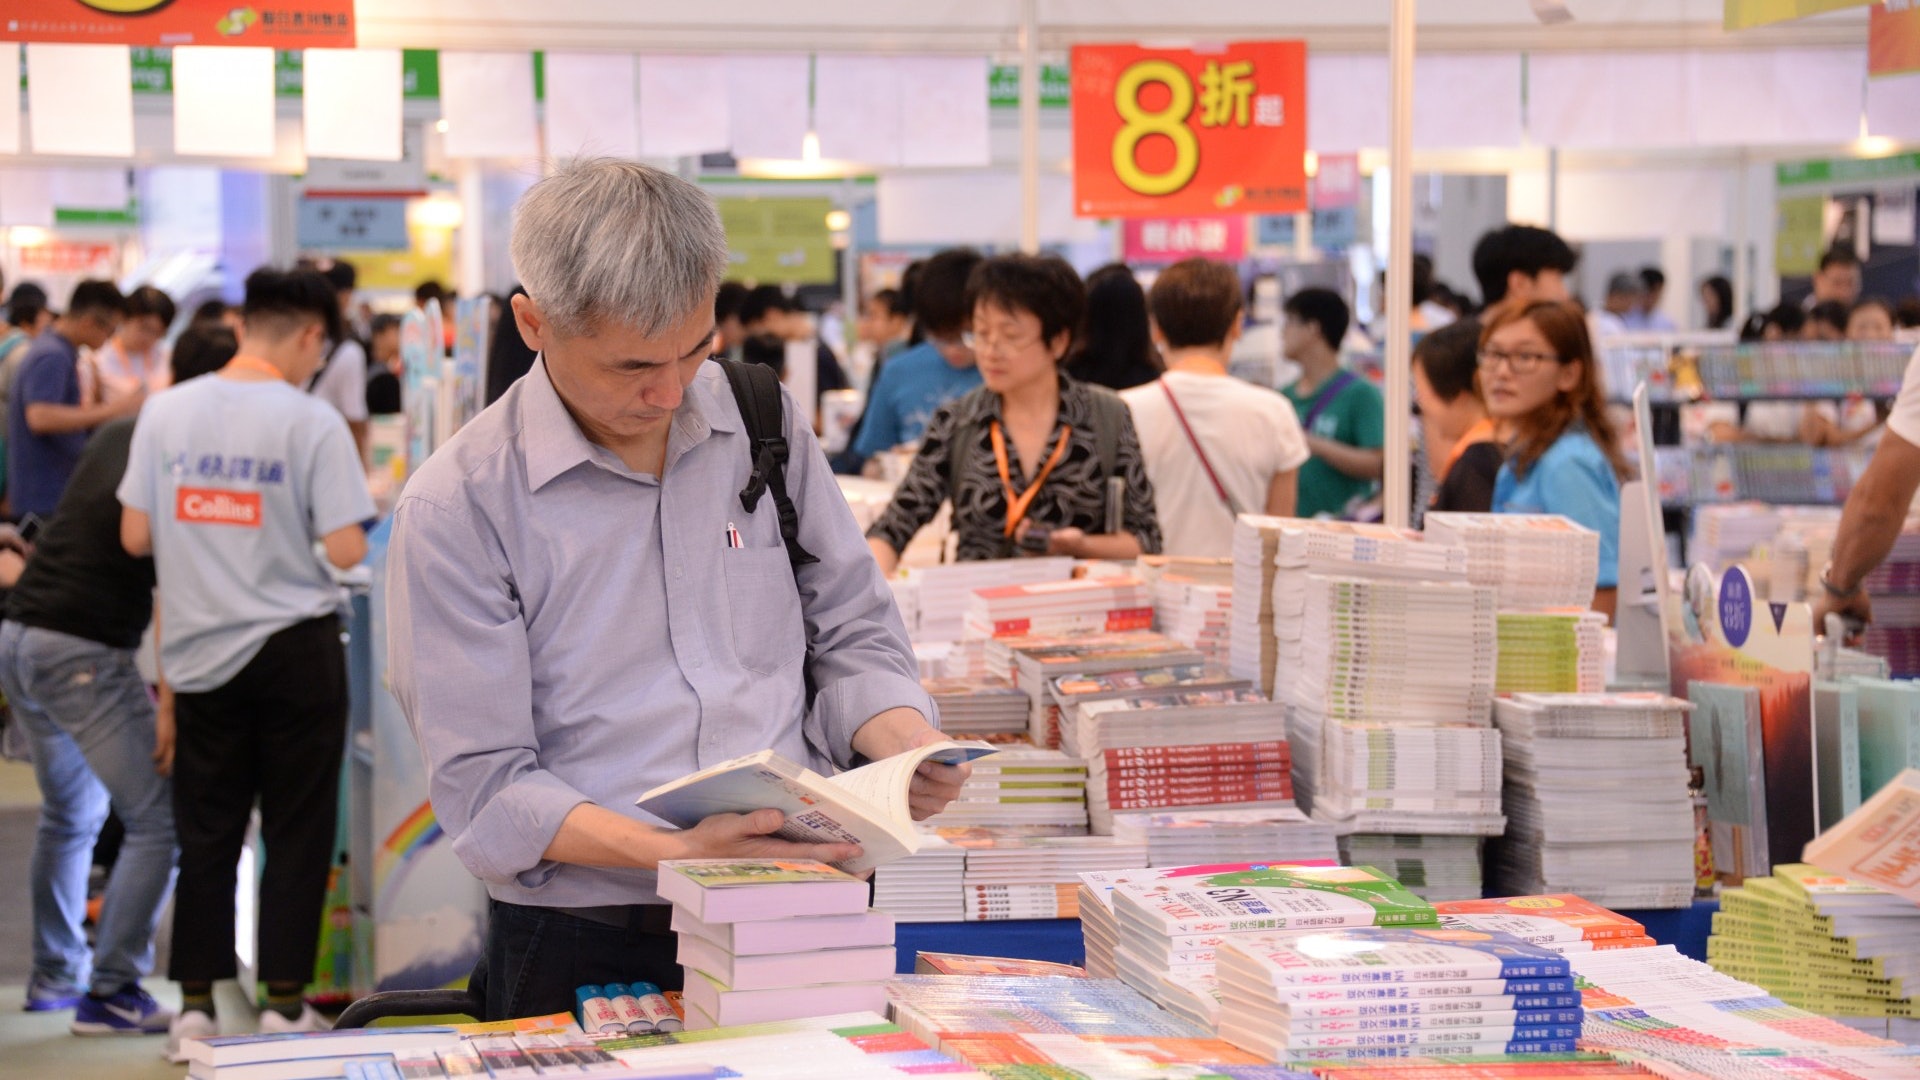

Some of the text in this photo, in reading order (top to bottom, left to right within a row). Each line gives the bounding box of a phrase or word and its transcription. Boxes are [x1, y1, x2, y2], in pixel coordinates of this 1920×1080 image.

[183, 493, 255, 521] Collins
[1205, 888, 1256, 903] N3
[1194, 921, 1226, 931] TRY!
[1200, 937, 1224, 946] TRY
